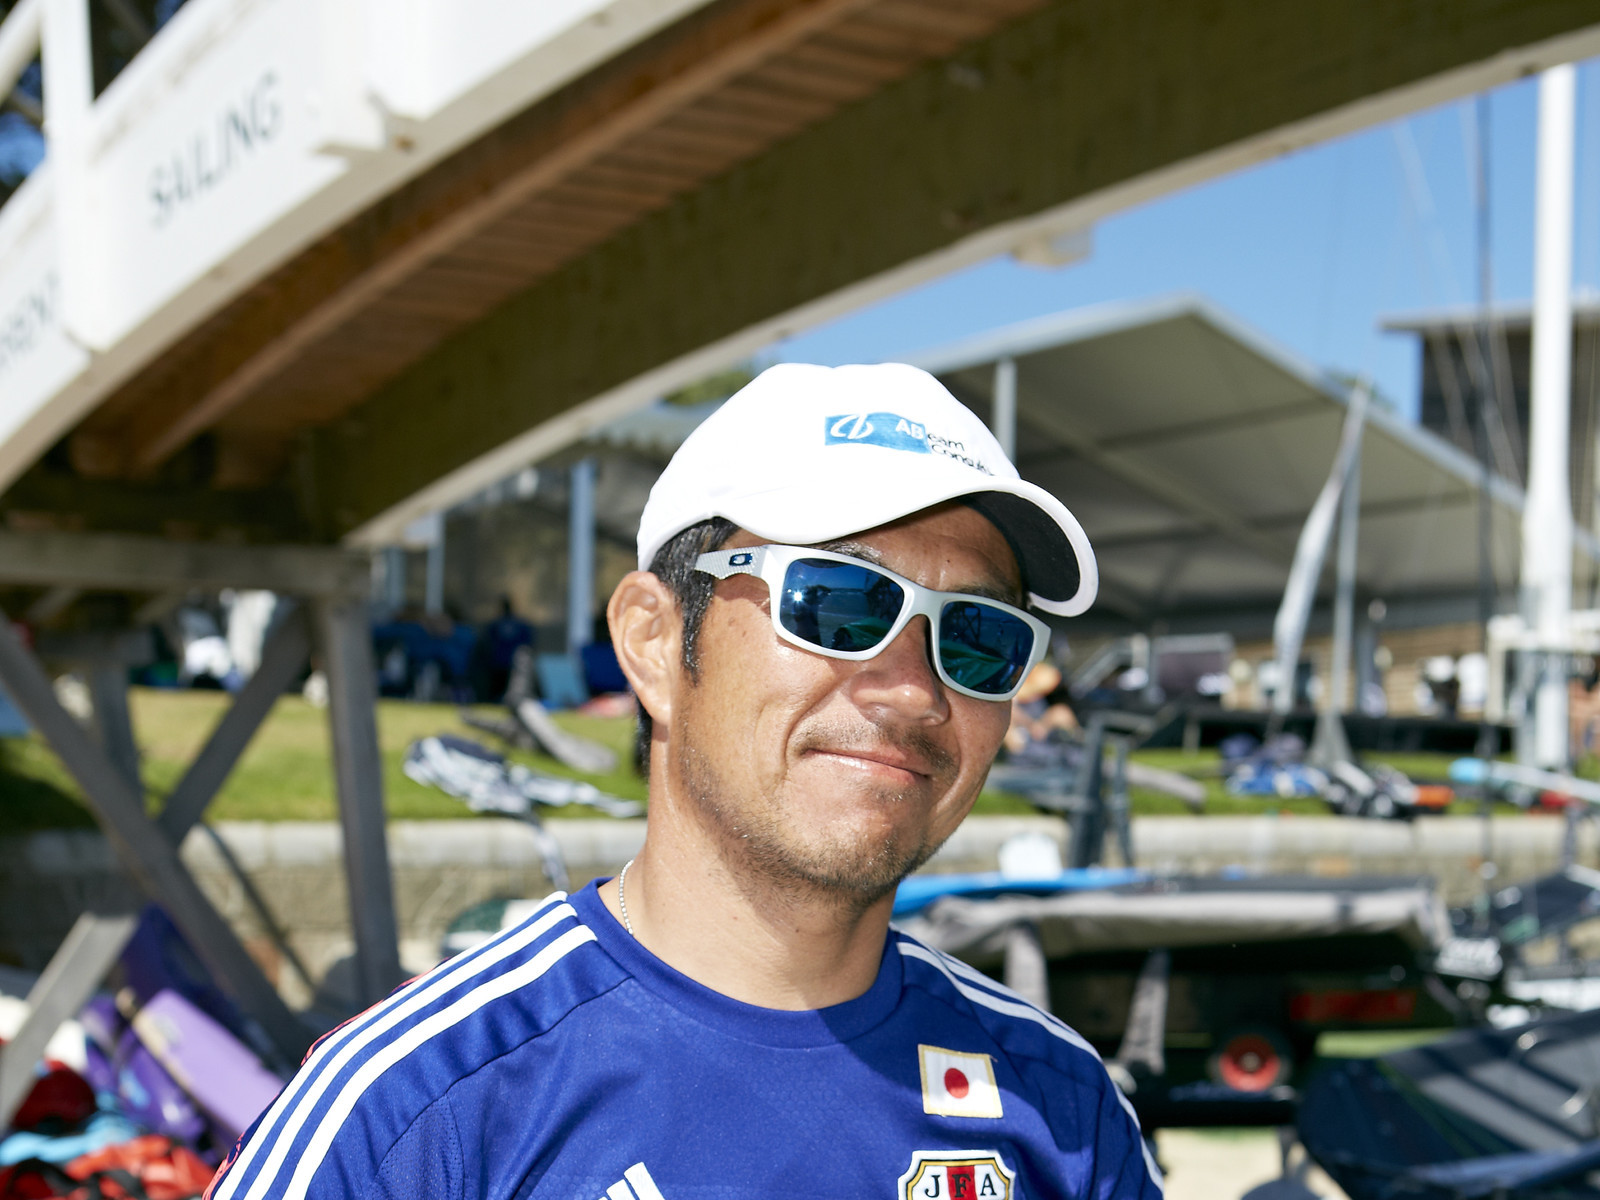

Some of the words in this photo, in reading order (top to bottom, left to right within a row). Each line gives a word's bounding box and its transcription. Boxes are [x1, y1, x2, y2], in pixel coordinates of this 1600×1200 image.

[147, 72, 284, 228] SAILING
[895, 418, 965, 451] ABeam
[925, 1173, 997, 1199] JFA
